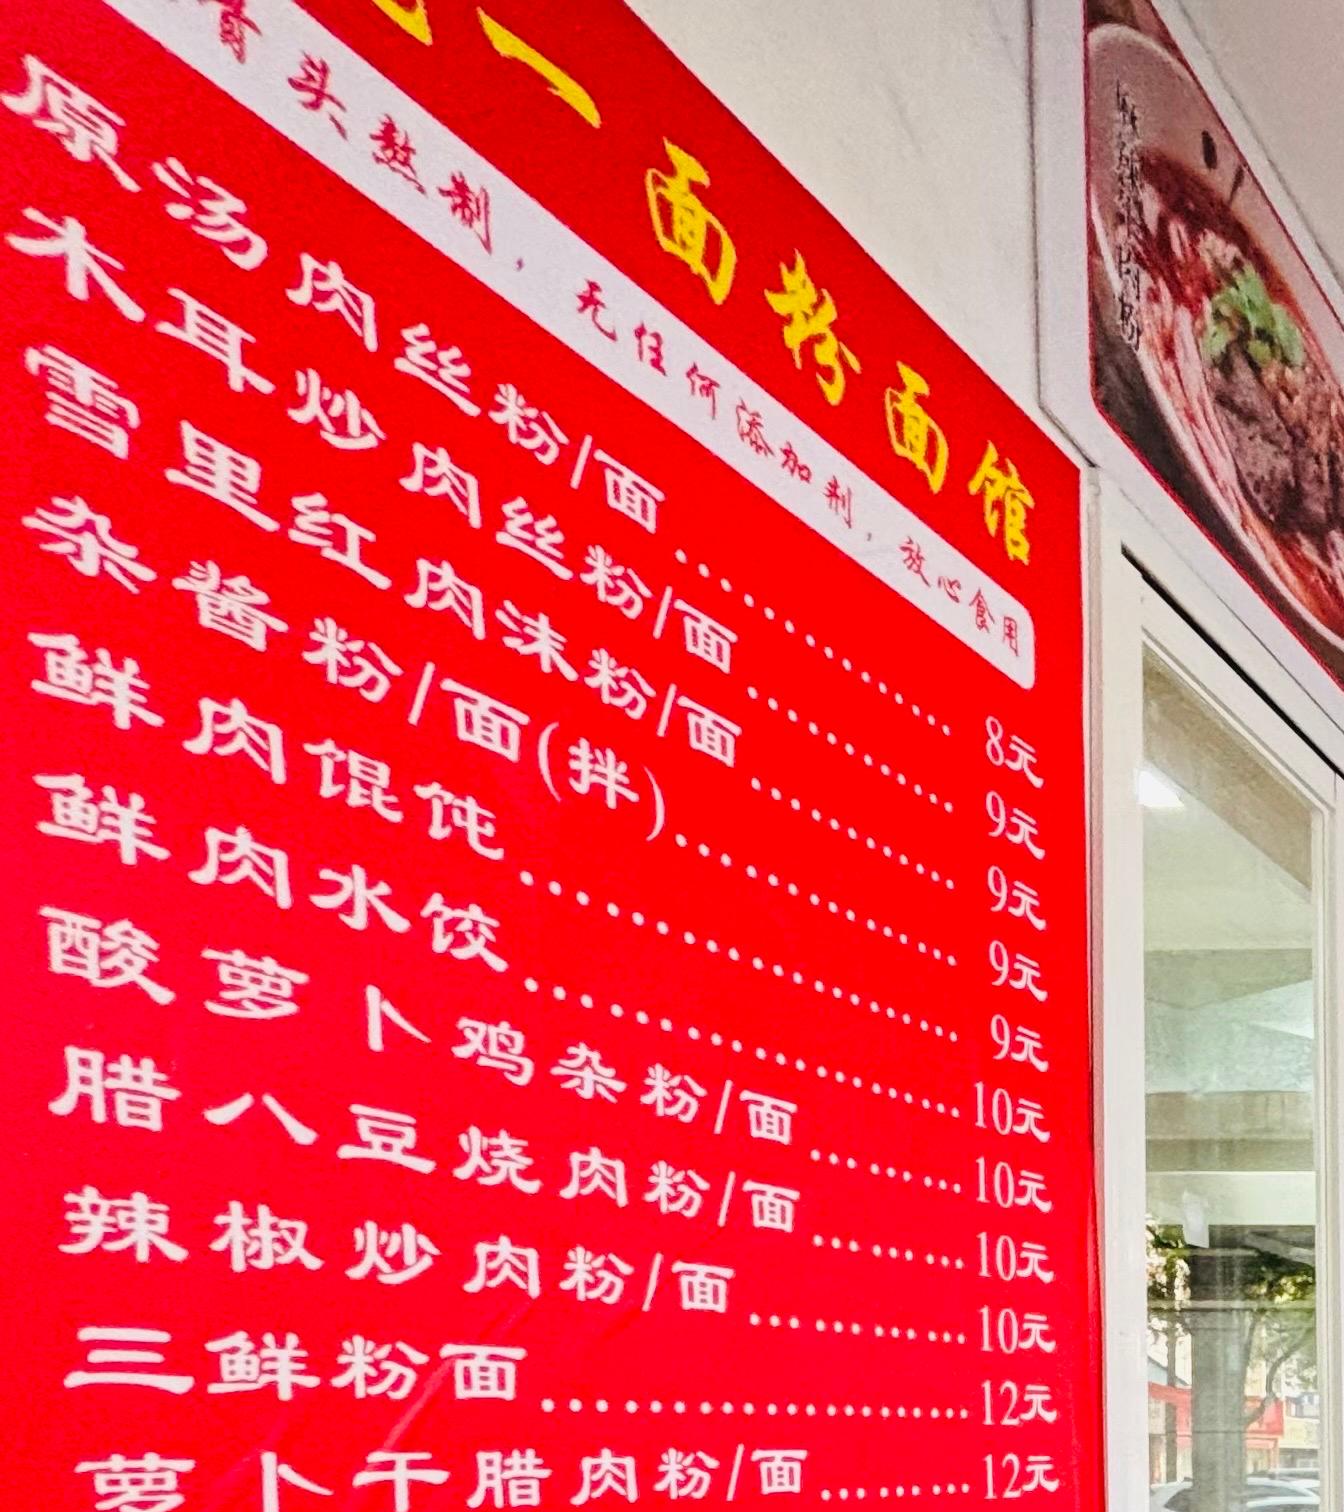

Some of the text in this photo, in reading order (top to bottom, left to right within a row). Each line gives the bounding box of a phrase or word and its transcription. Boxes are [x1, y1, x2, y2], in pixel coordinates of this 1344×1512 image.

[372, 0, 1035, 565] 一面粉面馆
[2, 54, 1044, 788] 原汤肉丝粉/面 8元
[6, 205, 1045, 860] 木耳炒肉丝粉/面 9元
[29, 631, 1048, 1072] 鲜肉馄饨 9元
[35, 773, 1050, 1143] 鲜肉水饺 10元
[988, 865, 1046, 931] 9元
[989, 940, 1047, 1002] 9元
[39, 906, 1052, 1213] 酸萝卜鸡杂粉/面 10元
[50, 1048, 1054, 1285] 腊八豆烧肉粉/面 10元
[59, 1186, 1055, 1354] 辣椒炒肉粉/面 10元
[63, 1324, 1058, 1425] 三鲜粉面 12元
[981, 1451, 1060, 1501] 12元
